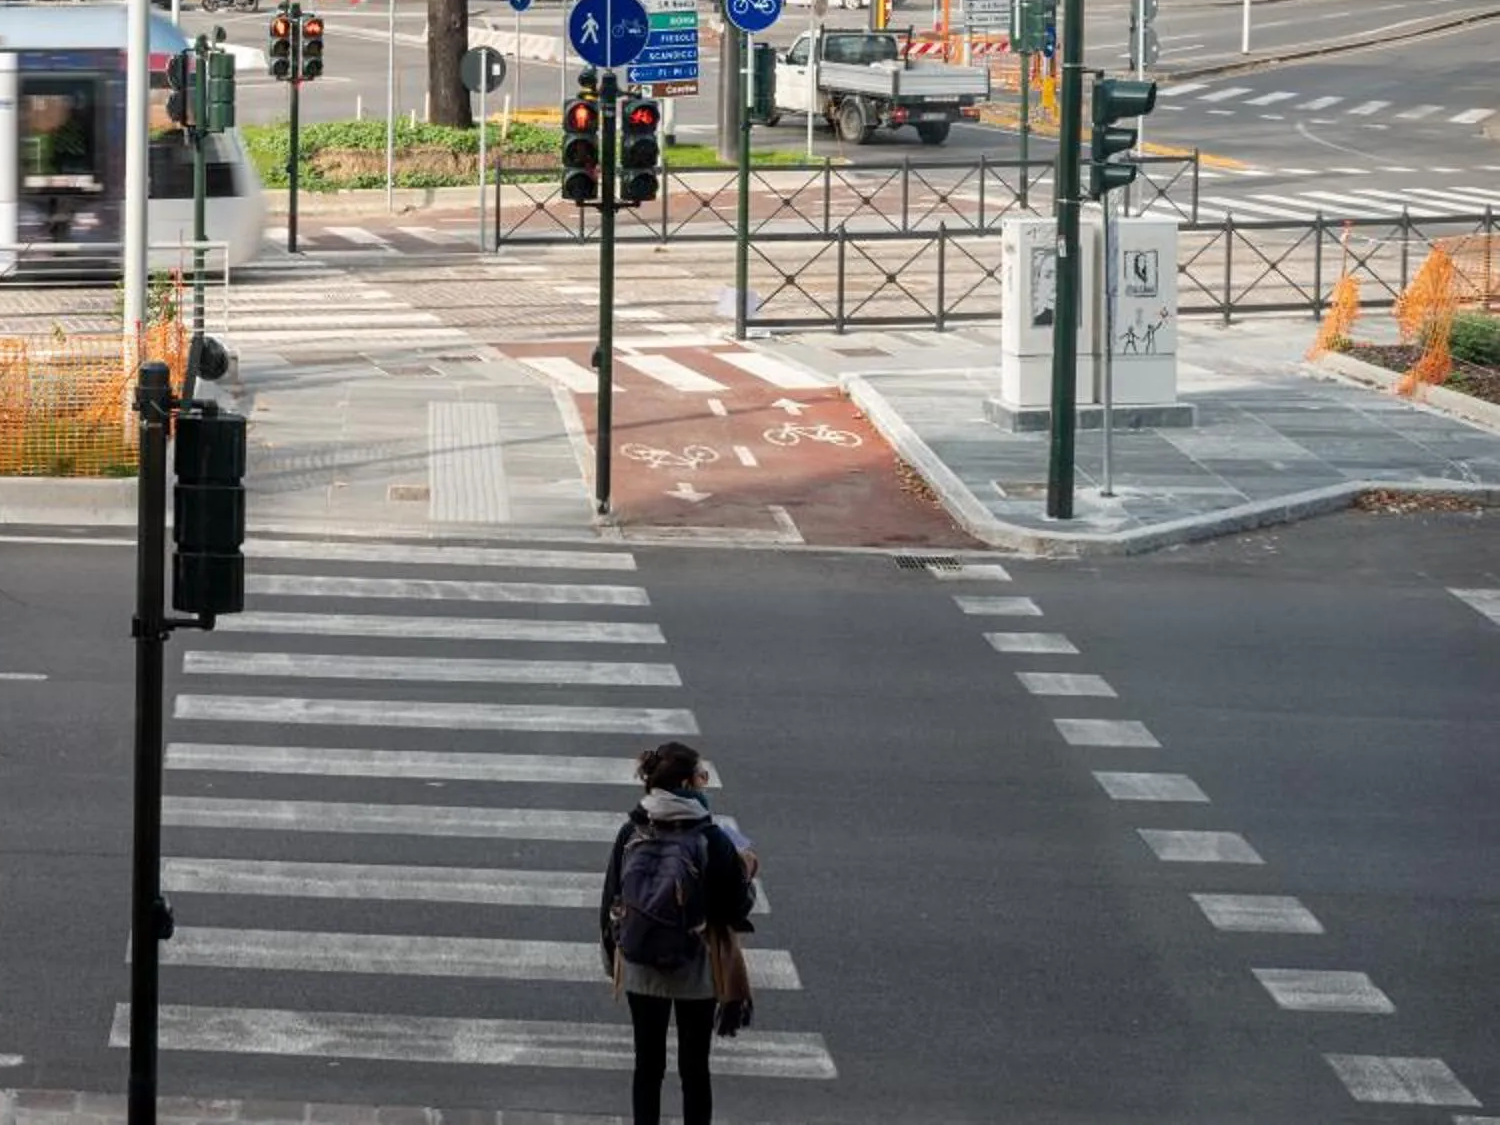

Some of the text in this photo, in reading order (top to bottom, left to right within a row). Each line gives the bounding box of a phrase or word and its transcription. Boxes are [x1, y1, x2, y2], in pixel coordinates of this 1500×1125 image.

[669, 16, 695, 25] ROMA
[660, 33, 696, 43] FIESOLE
[649, 50, 697, 60] SCANDICCI
